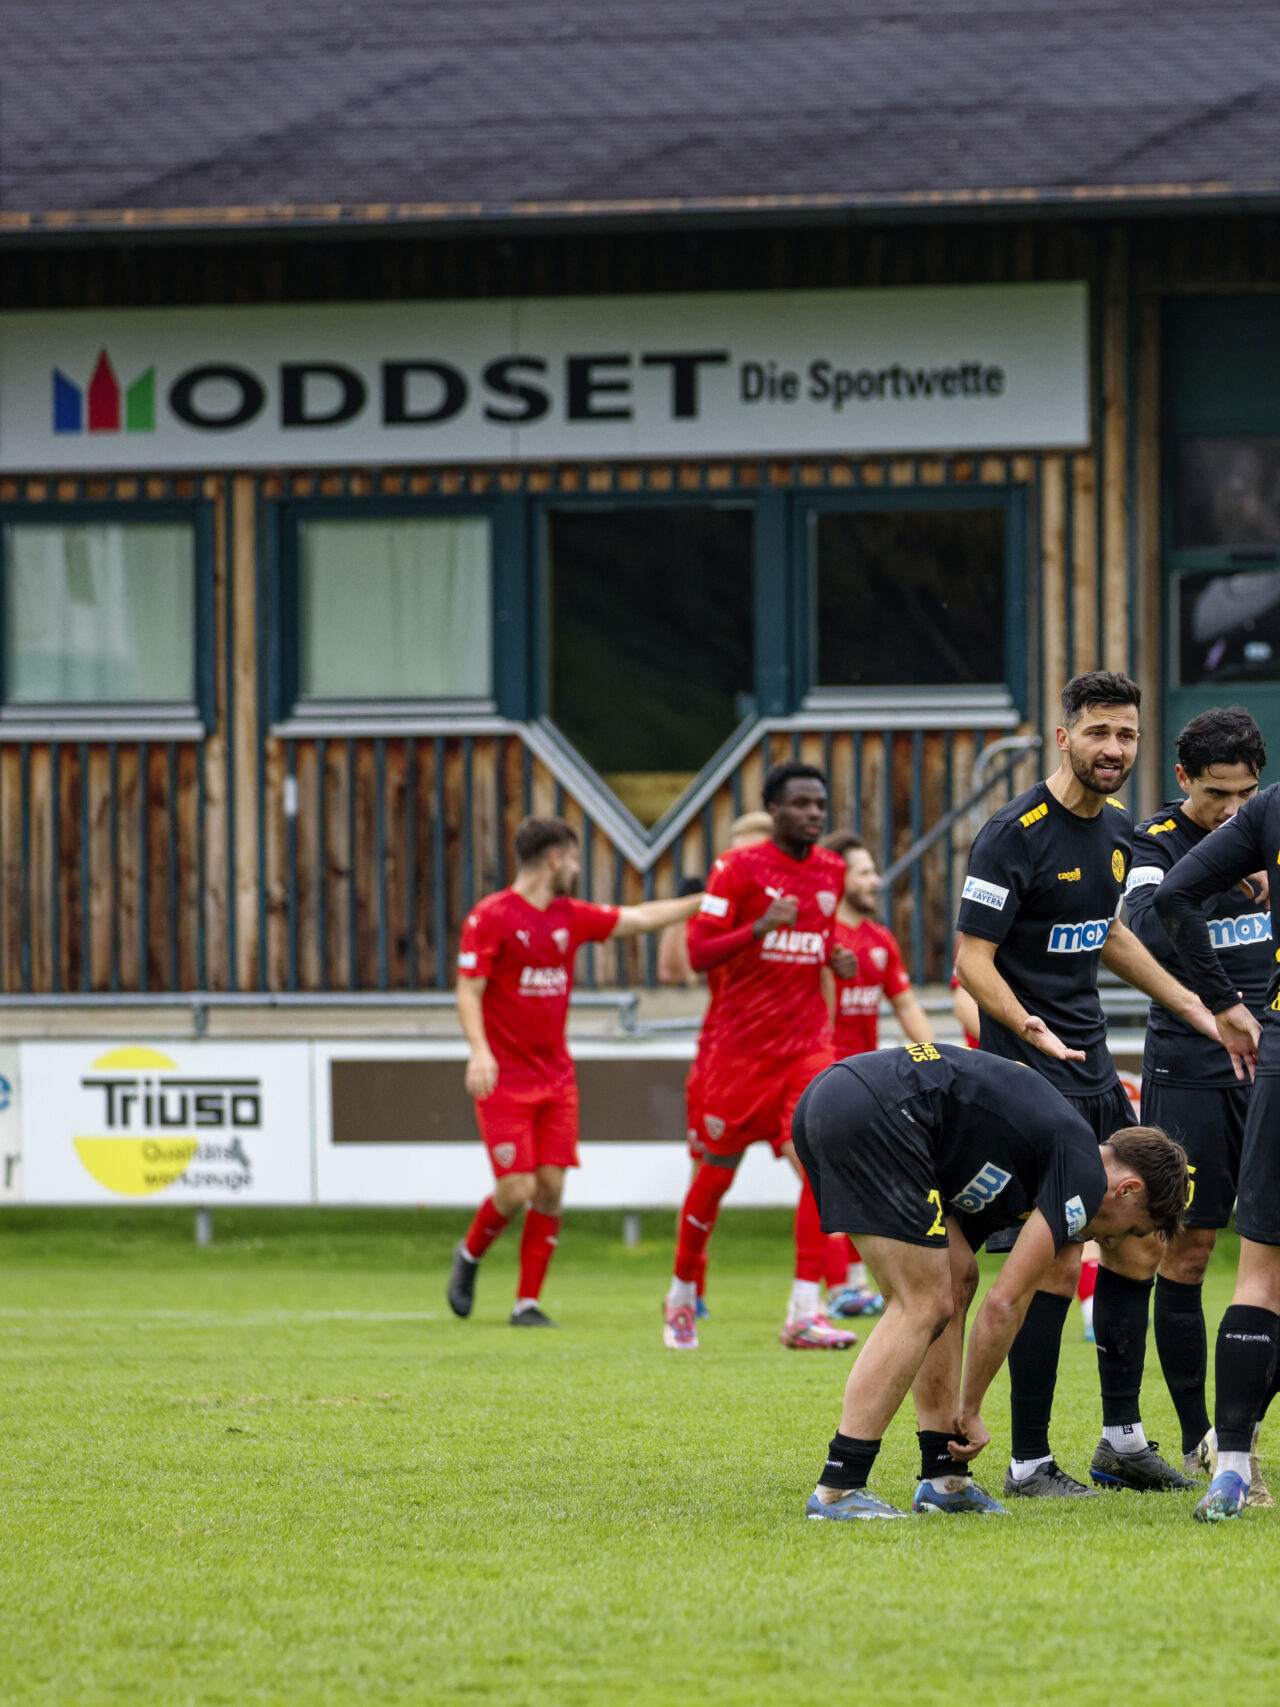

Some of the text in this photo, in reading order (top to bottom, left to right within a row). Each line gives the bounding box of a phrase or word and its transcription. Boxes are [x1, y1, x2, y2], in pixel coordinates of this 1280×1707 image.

[167, 352, 1006, 433] ODDSET Die Sportwette
[972, 891, 1003, 908] BAYERN
[80, 1079, 262, 1128] Triuso
